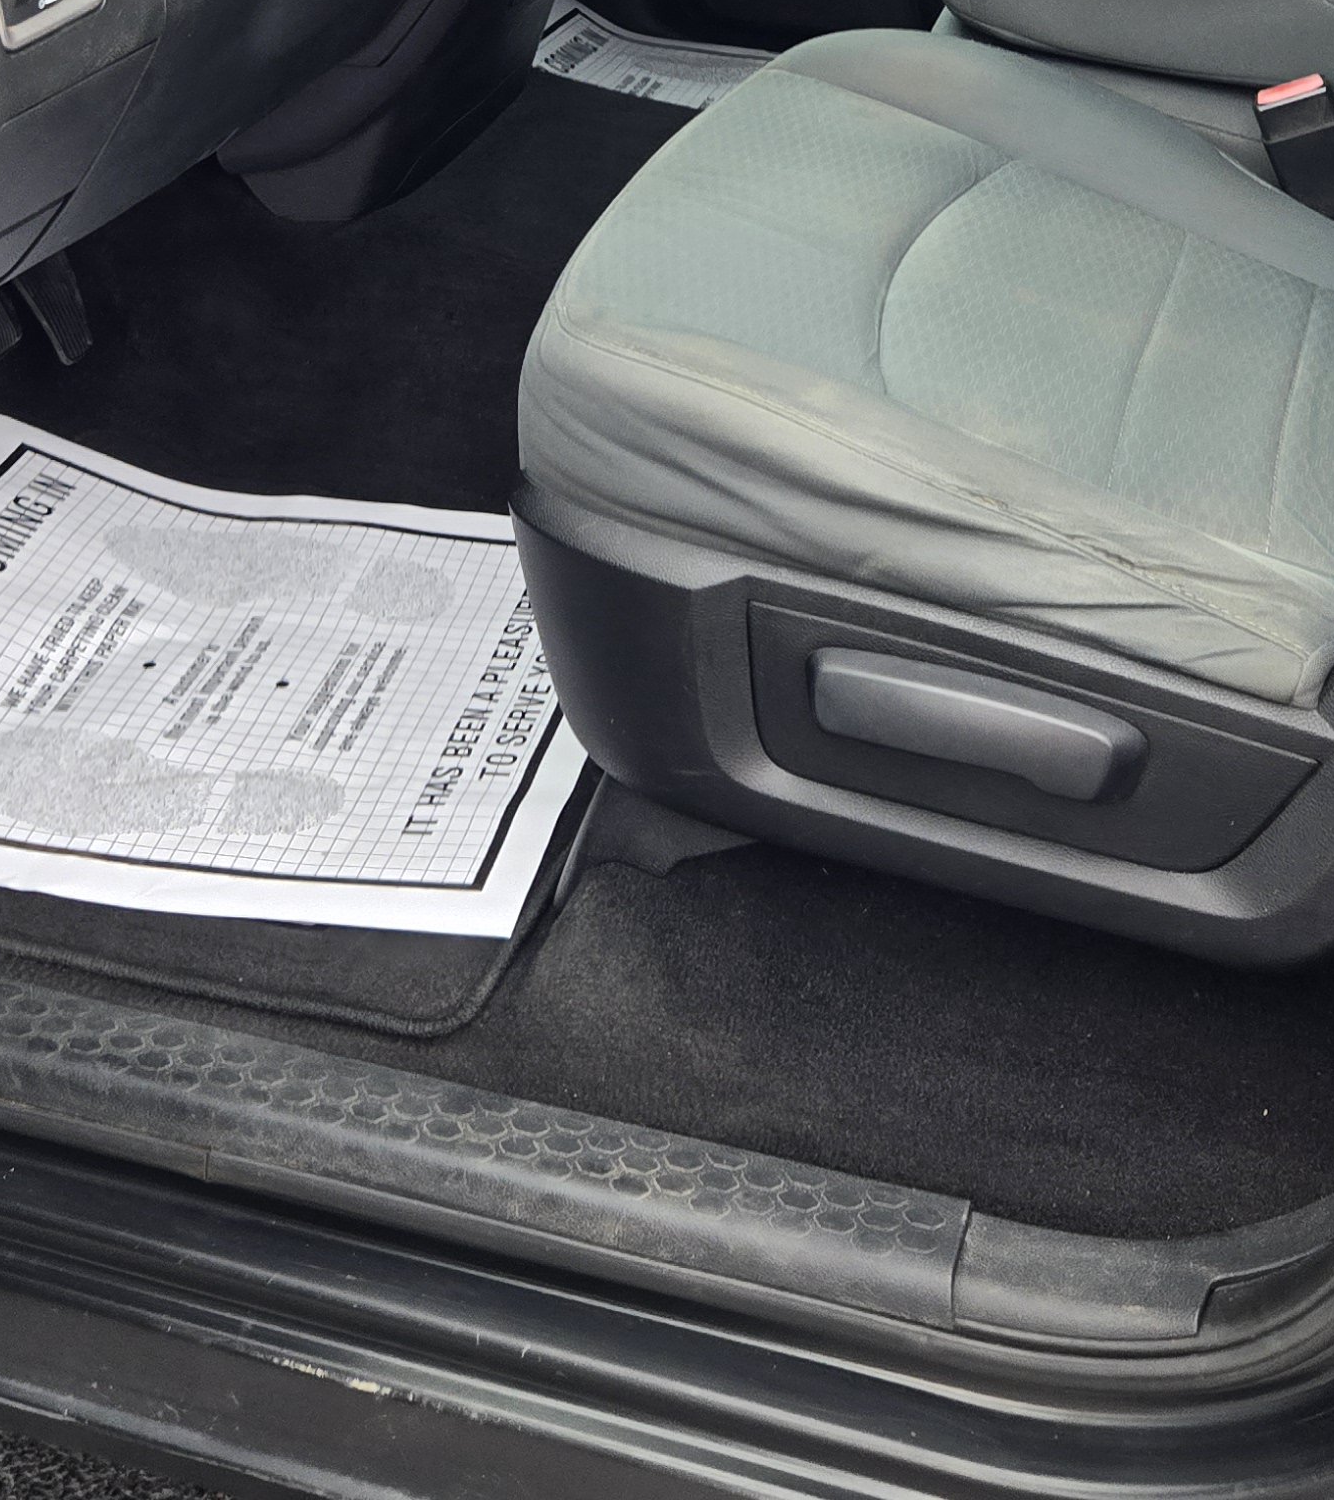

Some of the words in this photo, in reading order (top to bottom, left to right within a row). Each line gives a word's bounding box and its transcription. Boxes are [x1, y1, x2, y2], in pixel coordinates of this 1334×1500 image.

[27, 472, 77, 503] IN
[17, 652, 50, 688] HAVE
[40, 615, 75, 653] TRIED
[49, 613, 105, 683] CARPETING
[94, 616, 131, 659] PAPER
[471, 689, 504, 704] A
[495, 683, 552, 747] SERVE
[441, 706, 495, 758] BEEN
[418, 766, 464, 807] HAS
[479, 752, 518, 781] TO
[400, 815, 438, 836] IT
